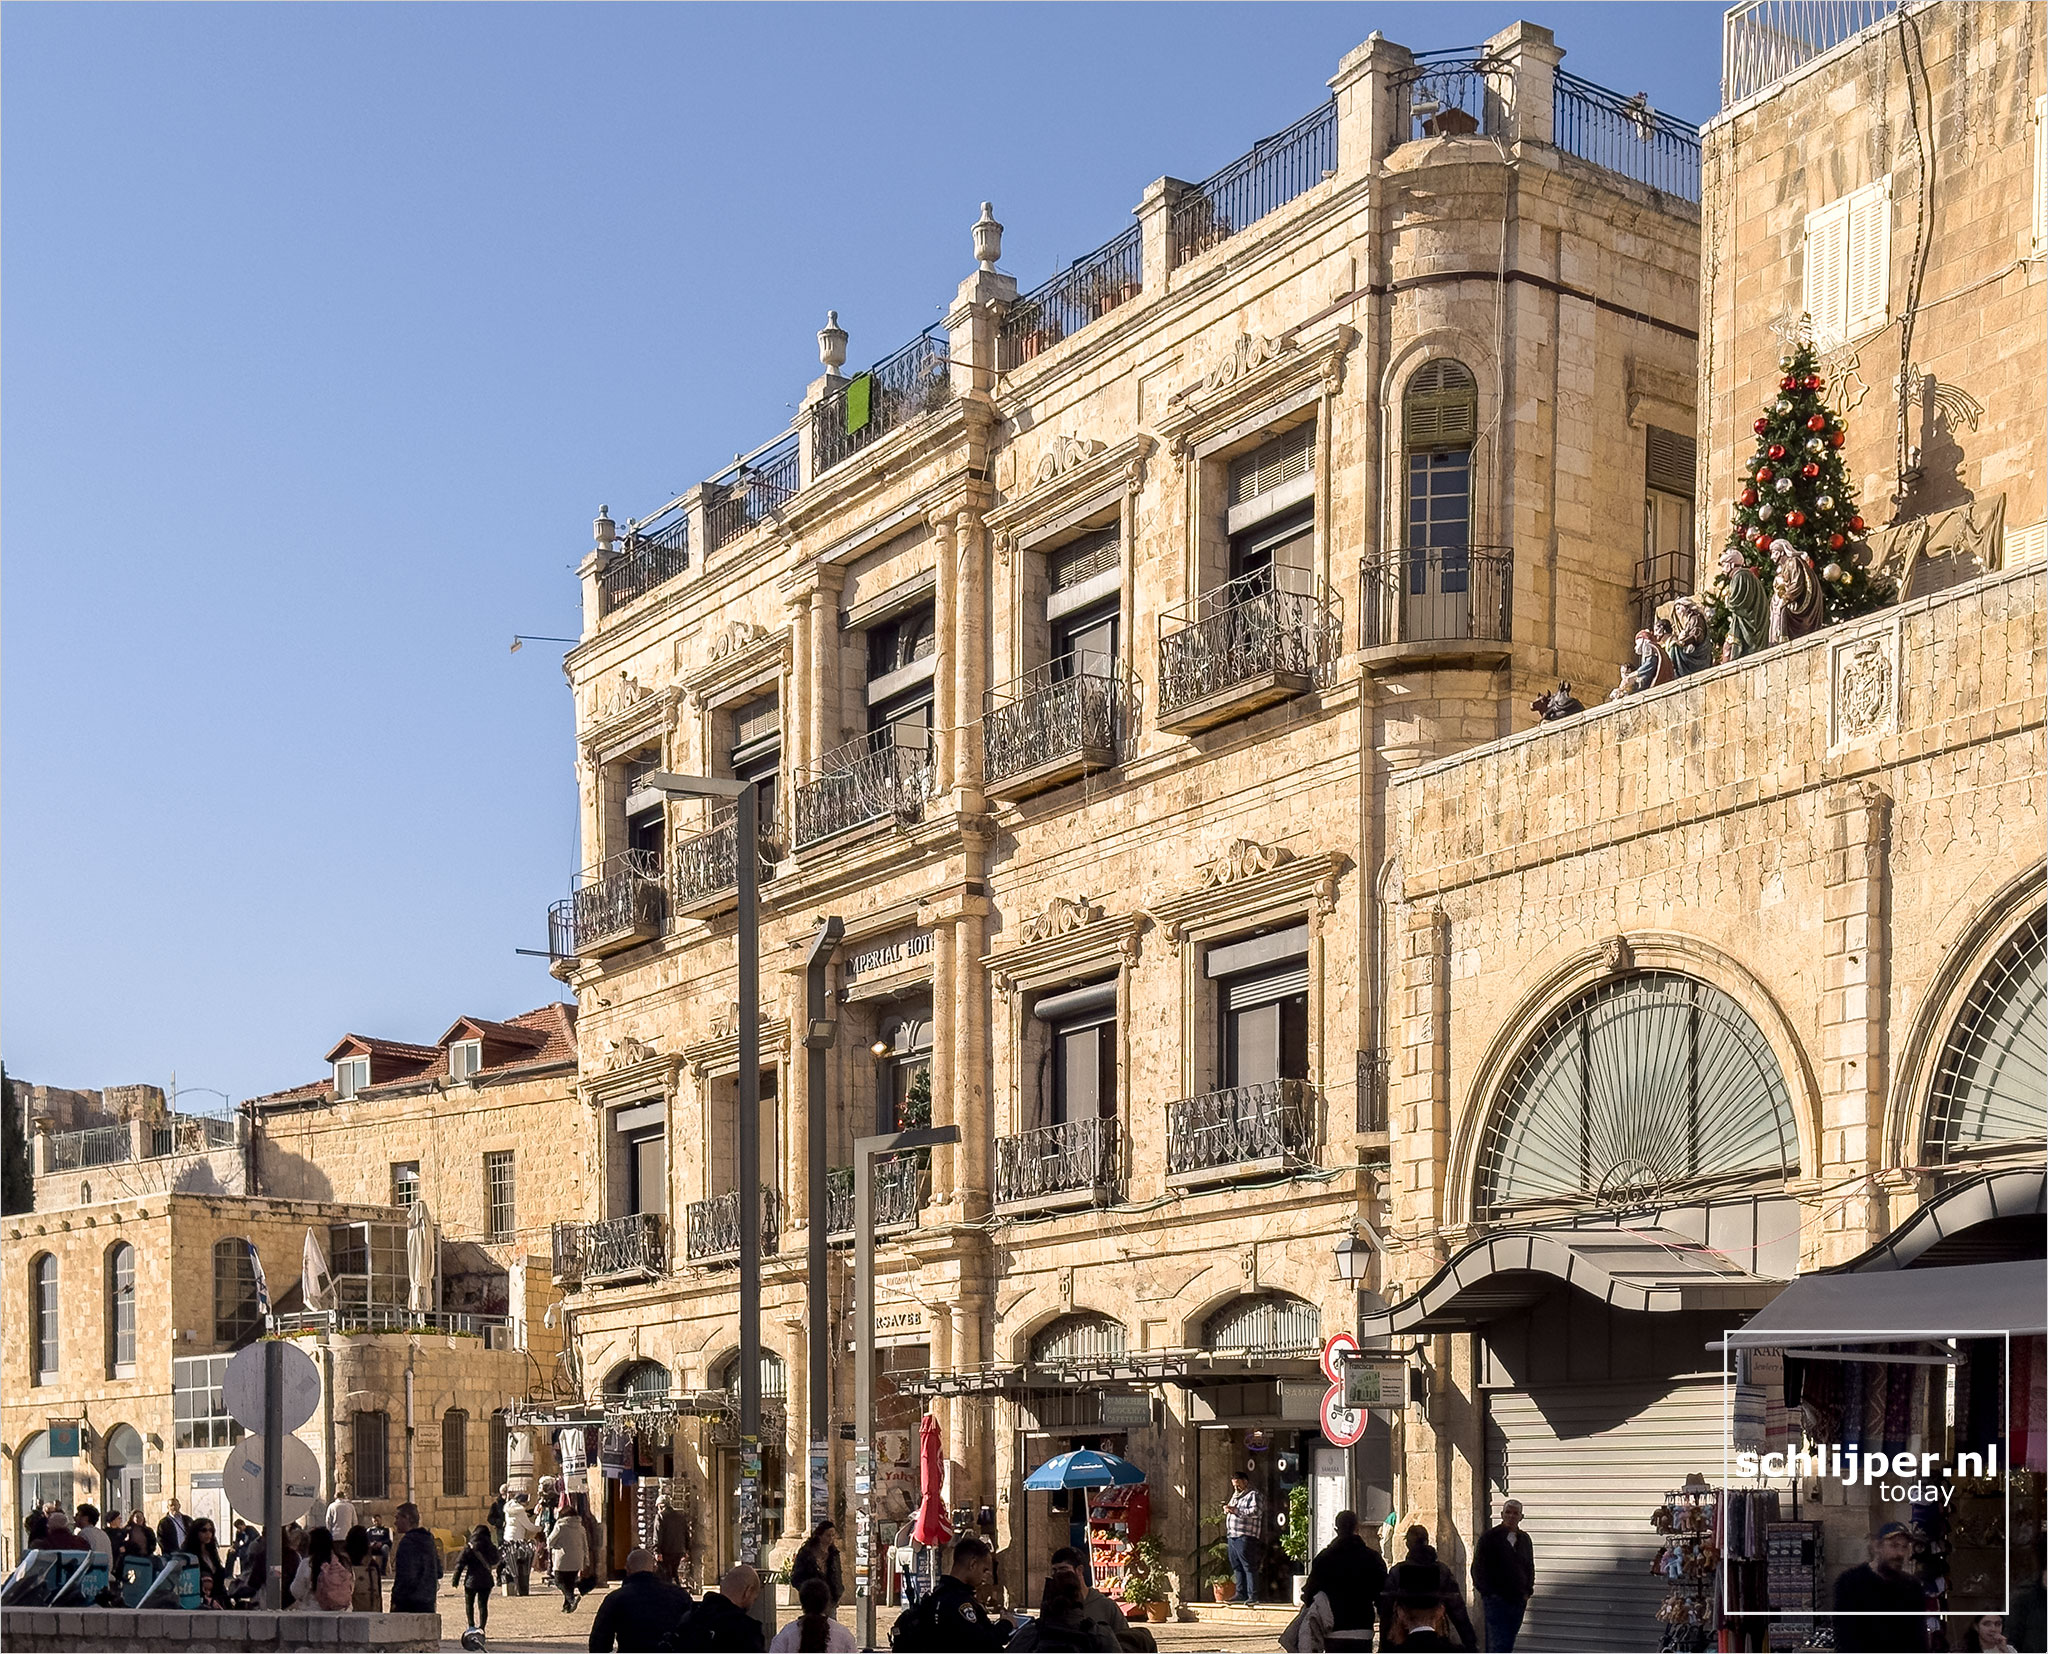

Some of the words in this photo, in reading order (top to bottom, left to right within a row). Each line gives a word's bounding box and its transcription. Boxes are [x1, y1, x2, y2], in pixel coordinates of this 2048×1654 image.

[845, 943, 903, 976] IMPERIAL
[906, 932, 935, 959] HOT
[876, 1312, 922, 1329] RSAVEE
